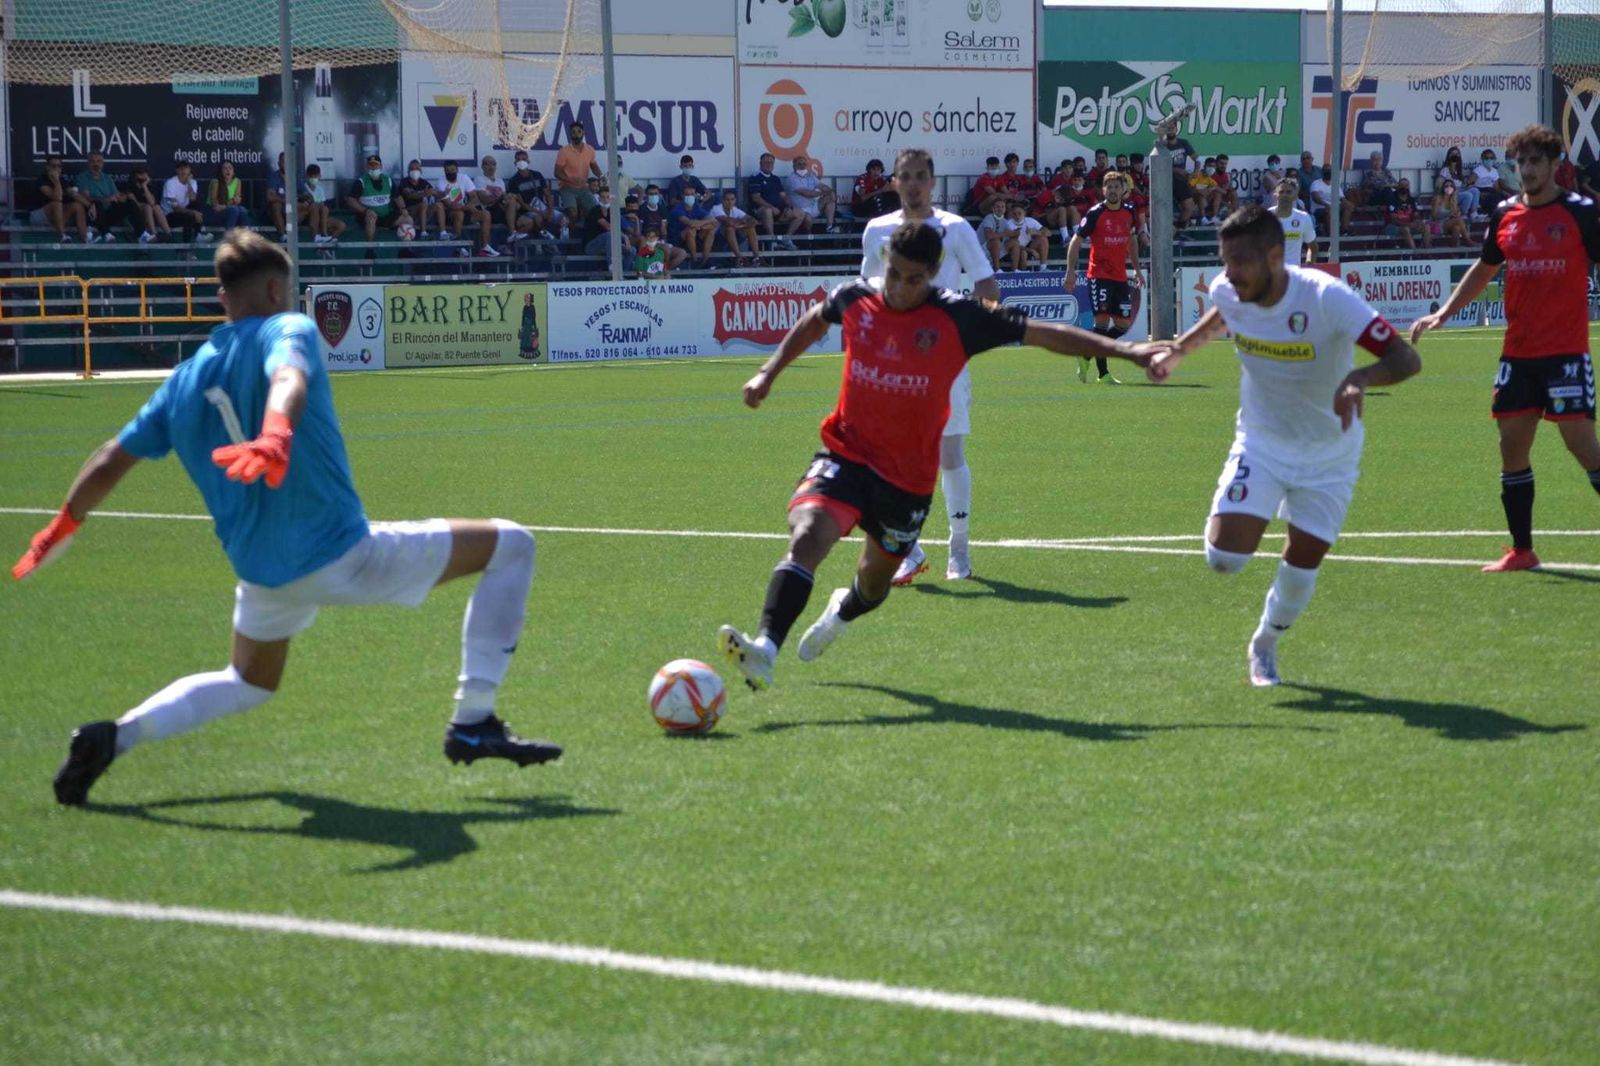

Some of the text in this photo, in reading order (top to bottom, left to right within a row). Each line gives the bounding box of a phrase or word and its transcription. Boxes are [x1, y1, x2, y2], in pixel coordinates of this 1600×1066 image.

[943, 31, 1020, 48] Salerm
[944, 54, 1020, 62] COSMETICS
[1408, 75, 1532, 91] TORNOS Y SUMINISTROS
[186, 103, 249, 122] Rejuvenece
[1052, 86, 1288, 136] Petro Markt
[1434, 101, 1500, 122] SANCHEZ
[835, 97, 1017, 143] arroyo sánchez
[32, 127, 147, 156] LENDAN
[192, 126, 245, 142] el cabello
[1406, 134, 1466, 149] Soluciones
[174, 148, 262, 163] desde el interior
[1374, 265, 1431, 277] MEMBRILLO
[552, 284, 694, 297] YESOS PROYECTADOS Y A MANO
[1050, 278, 1060, 287] DE
[1365, 280, 1442, 302] SAN LORENZO
[390, 289, 513, 325] BAR REY
[584, 300, 664, 329] YESOS Y ESCAYOLAS
[392, 331, 513, 344] El Rincón del Manantero
[1371, 322, 1390, 341] C
[328, 352, 359, 364] ProLiga
[455, 350, 481, 360] Puente
[585, 348, 600, 359] 620
[603, 348, 620, 358] 816
[622, 347, 638, 358] 064
[646, 346, 661, 357] 610
[663, 345, 679, 356] 444
[682, 344, 697, 355] 733
